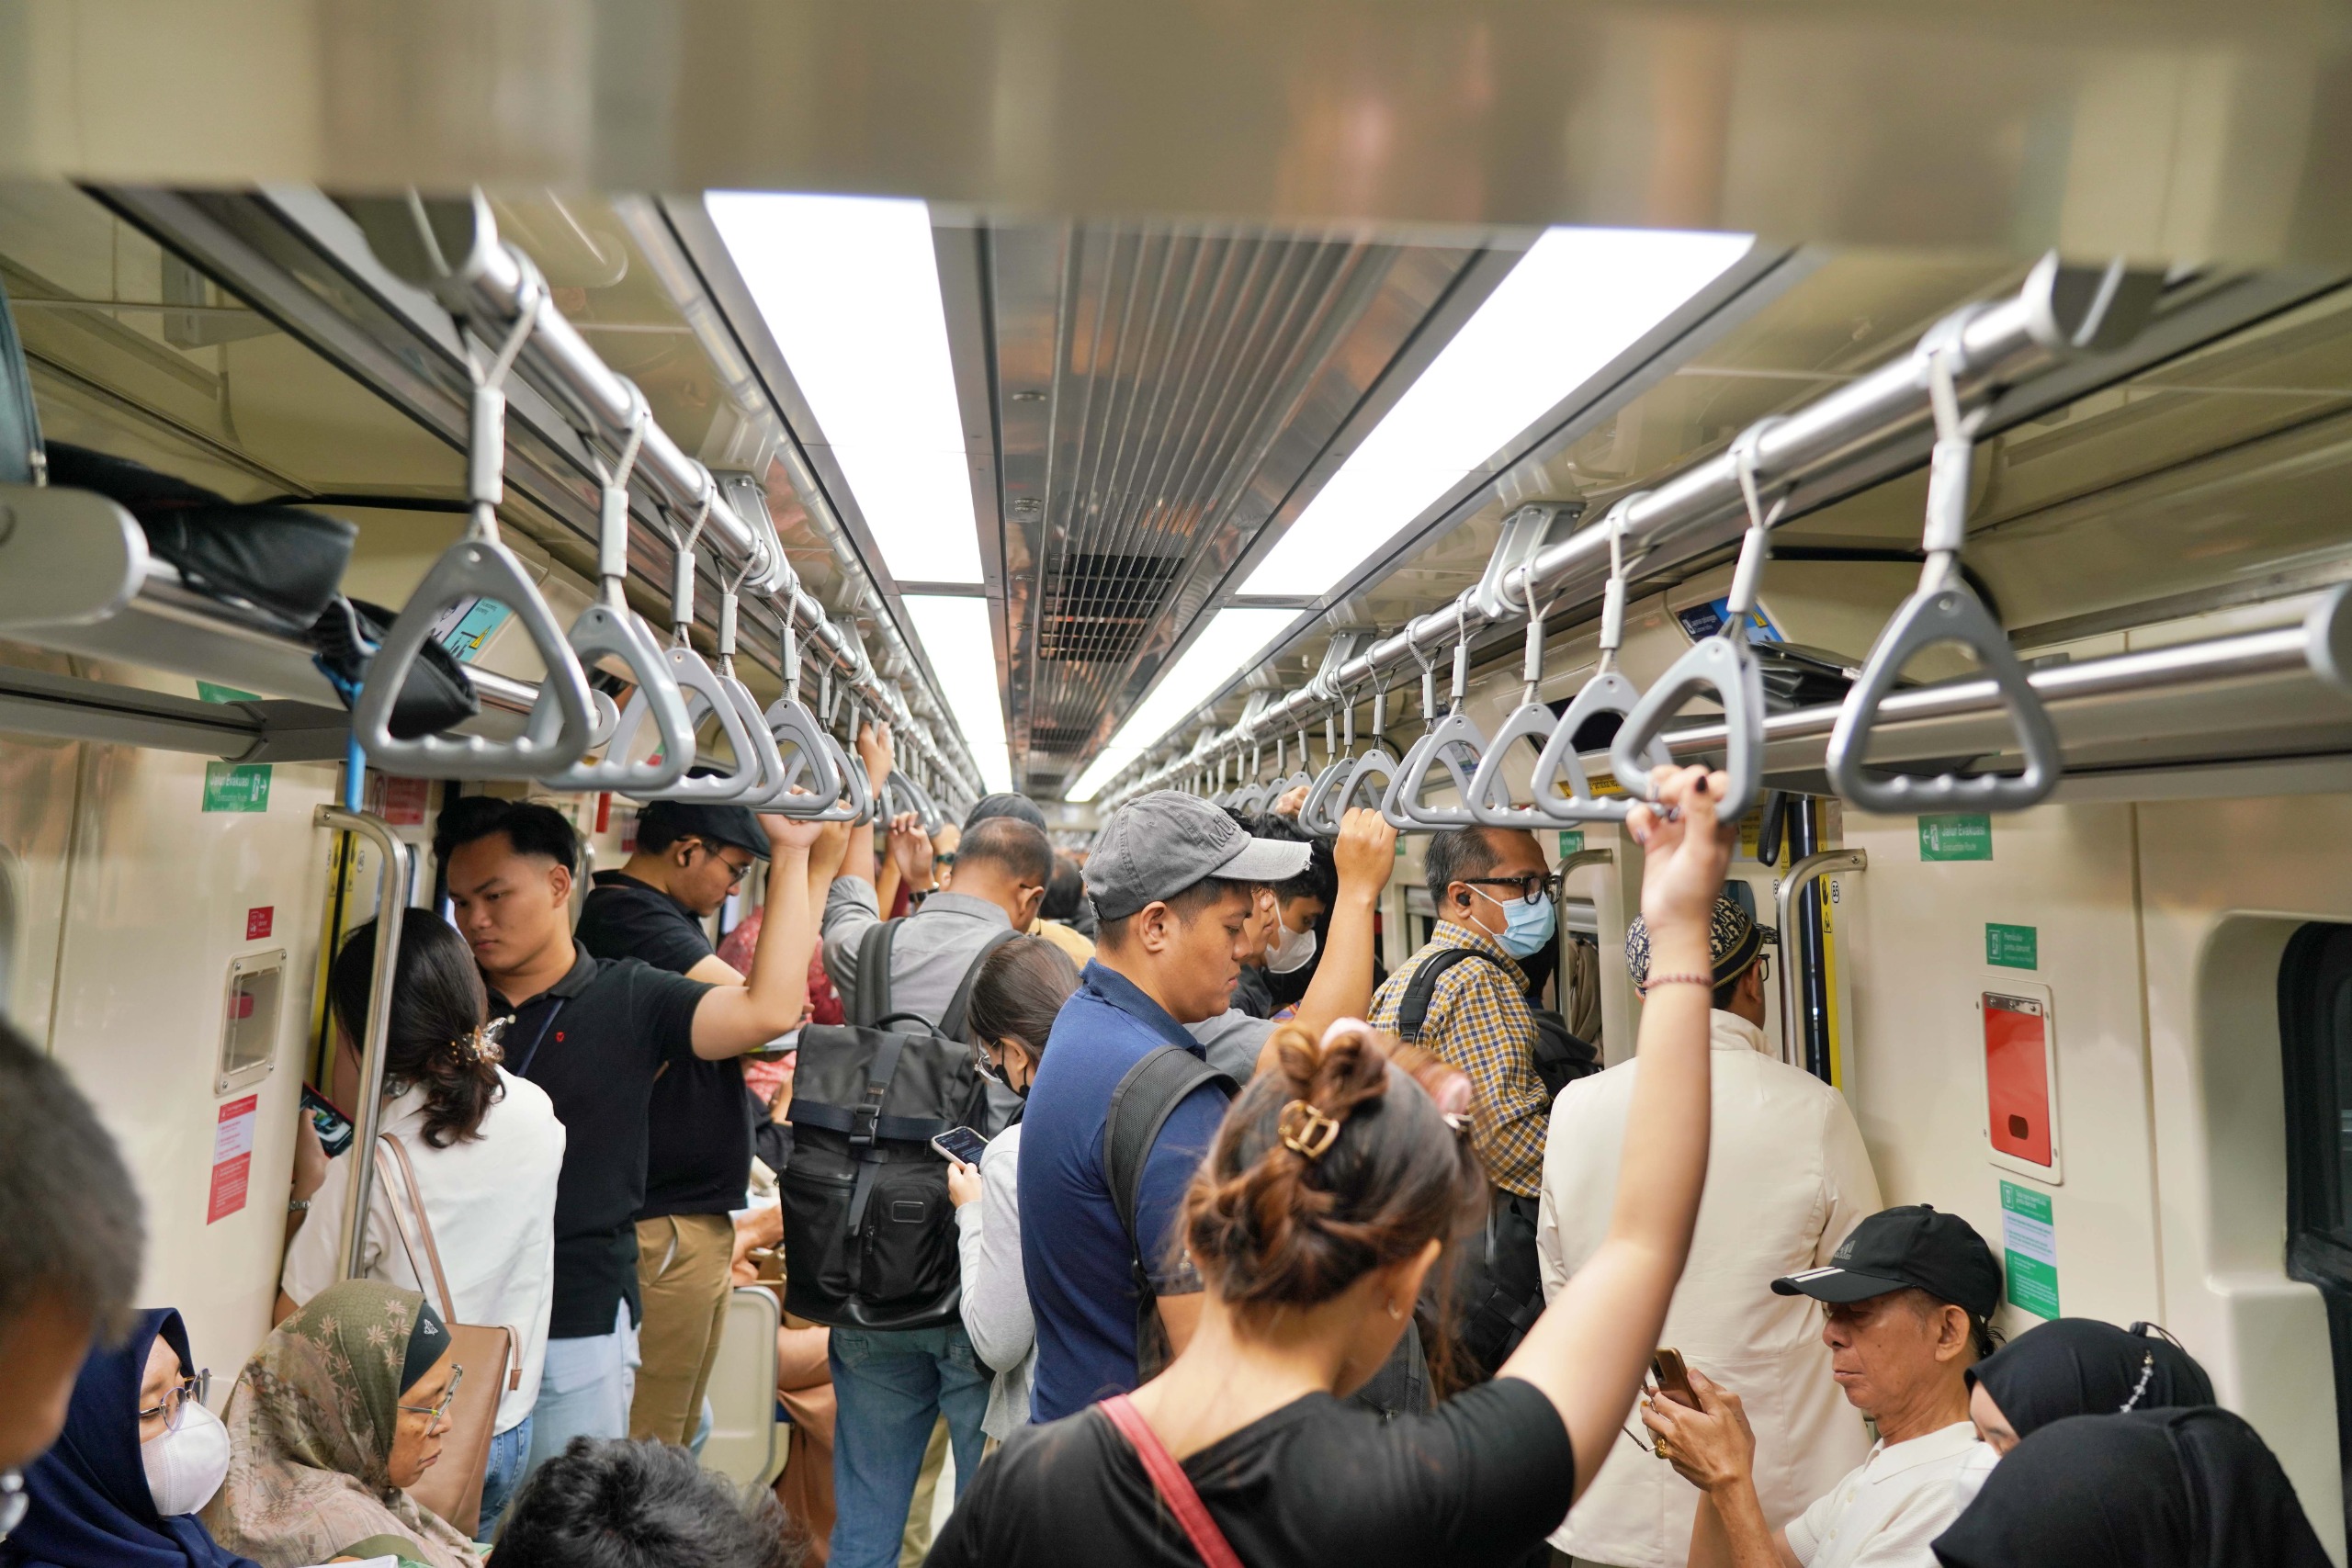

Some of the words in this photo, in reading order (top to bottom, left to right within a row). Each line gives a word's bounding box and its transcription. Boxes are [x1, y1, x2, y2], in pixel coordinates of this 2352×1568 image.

[210, 773, 225, 786] Jalur
[226, 773, 250, 787] Evakuasi
[1941, 823, 1957, 837] Jalur
[1958, 823, 1985, 837] Evakuasi
